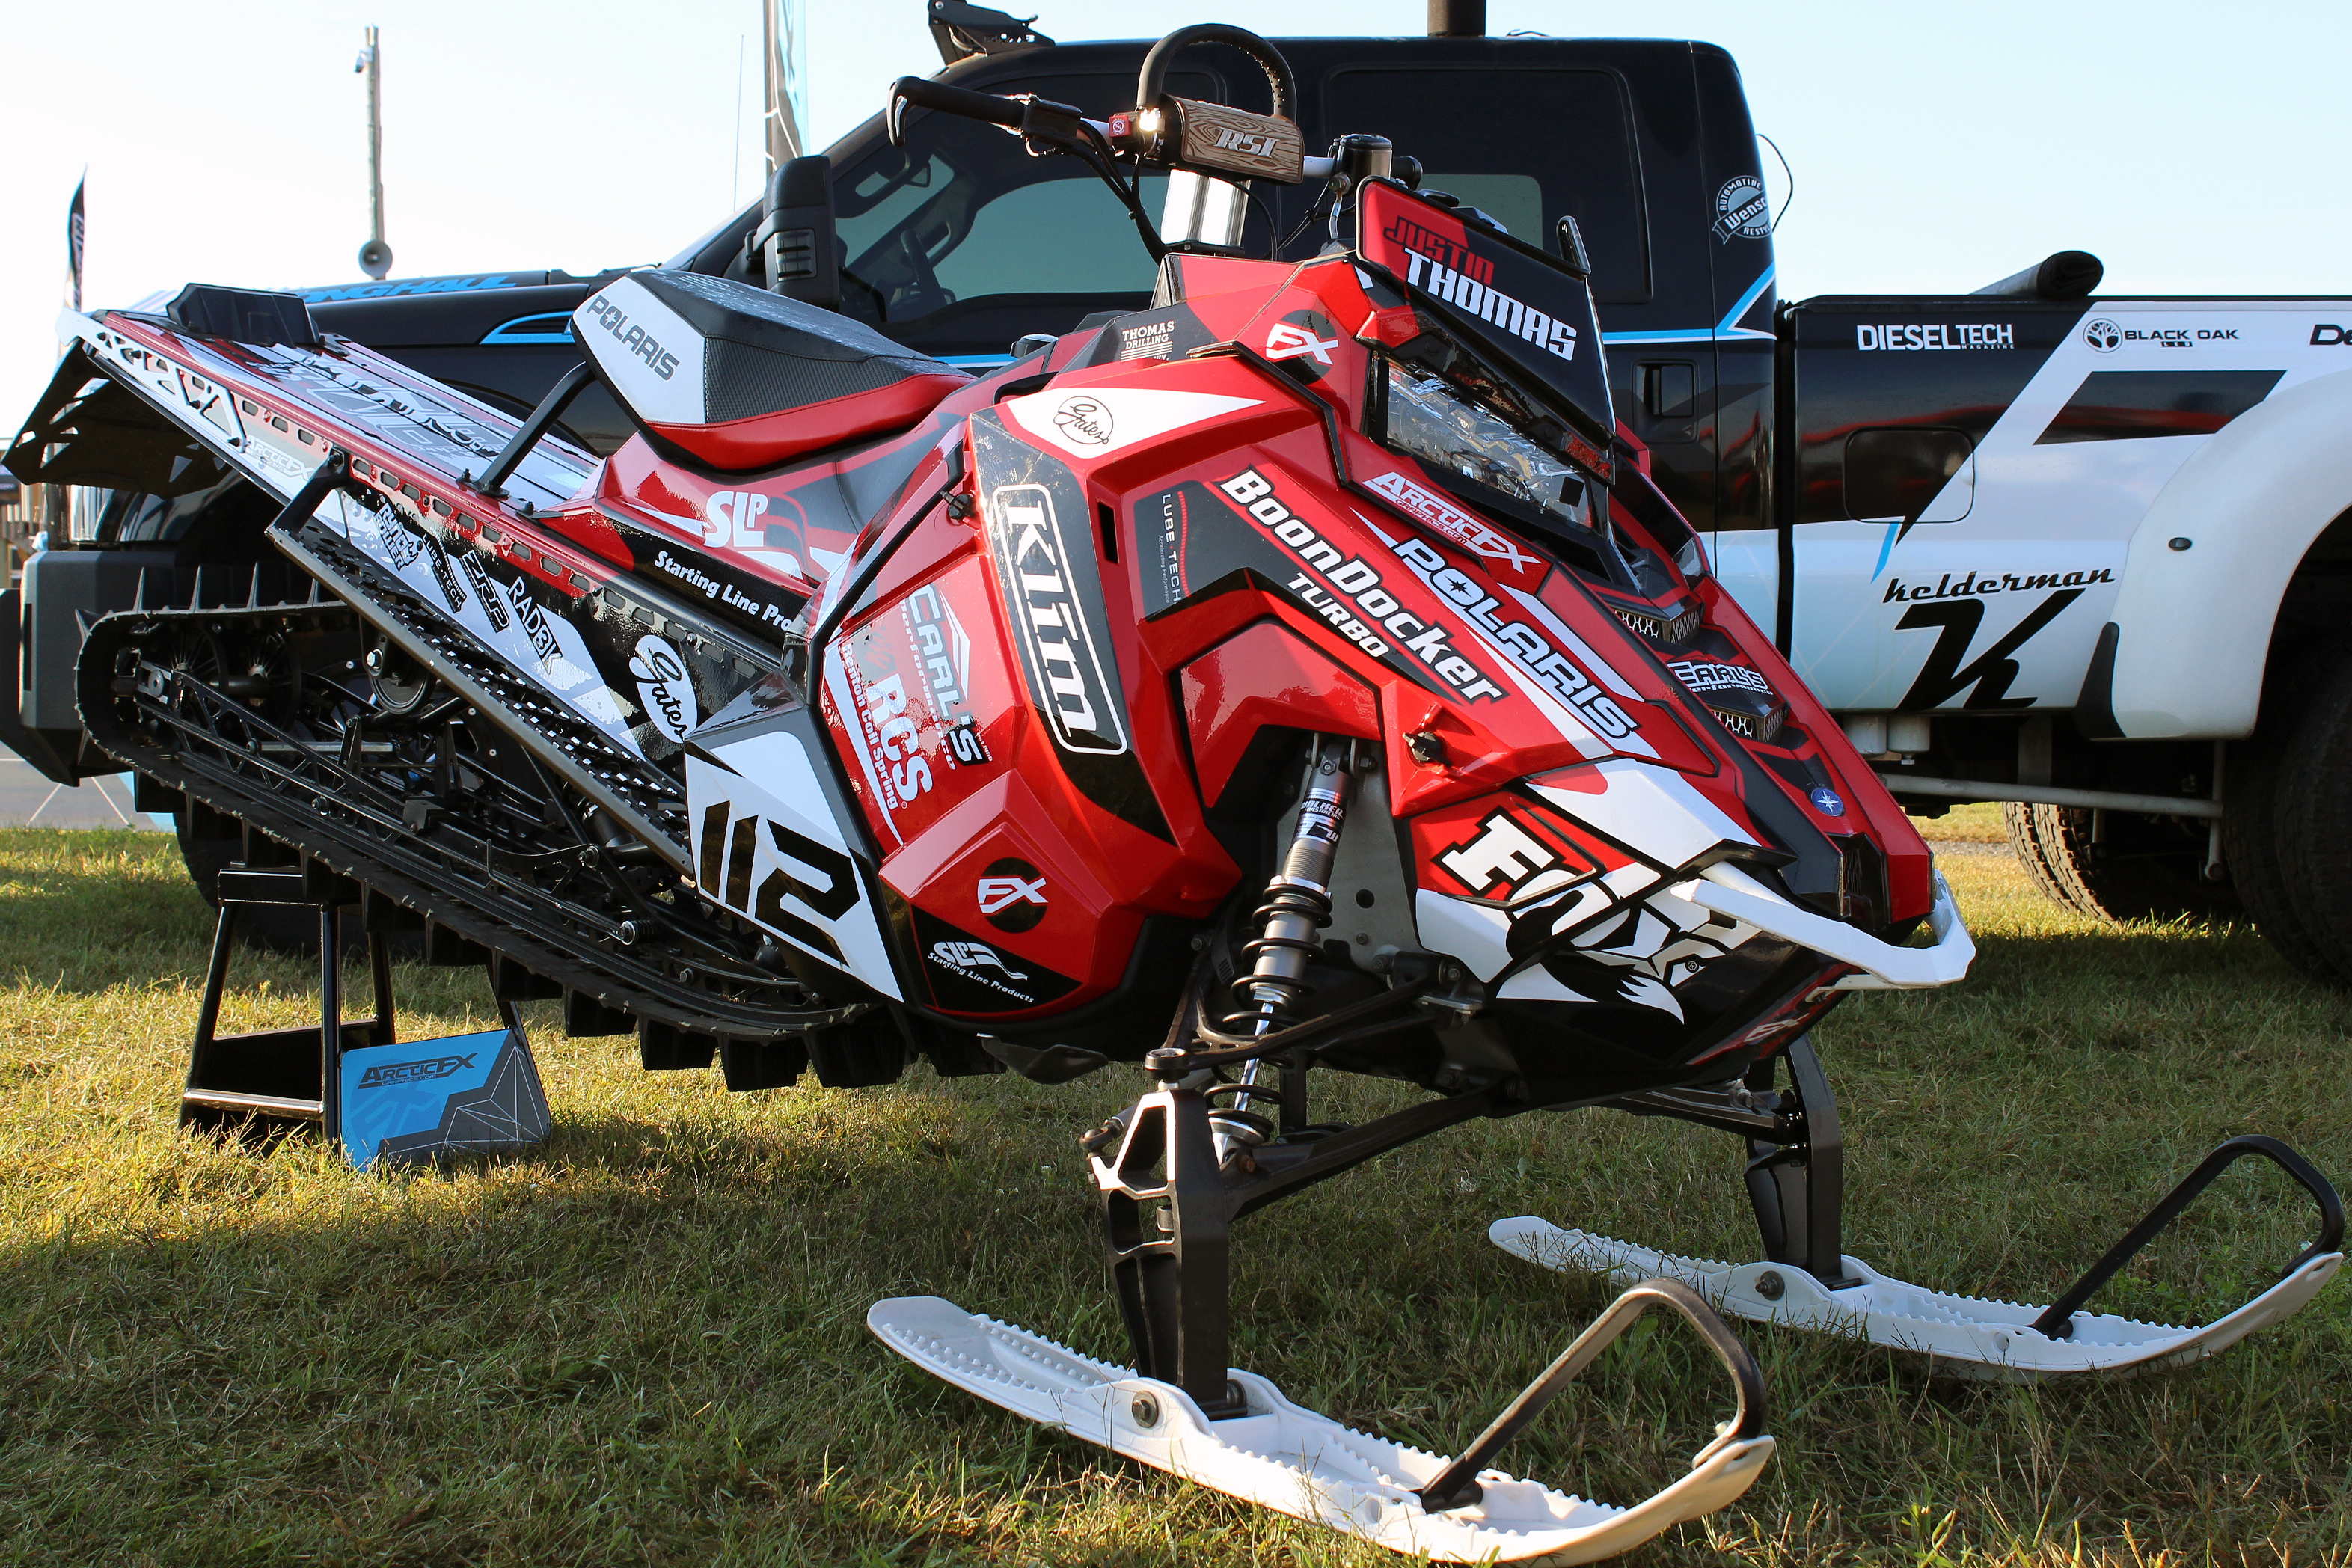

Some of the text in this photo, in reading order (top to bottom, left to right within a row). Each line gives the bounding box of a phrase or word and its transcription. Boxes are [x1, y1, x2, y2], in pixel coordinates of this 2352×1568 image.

[1213, 126, 1280, 158] RSI
[586, 294, 681, 382] POLARIS
[1122, 320, 1175, 342] THOMAS
[1404, 247, 1578, 361] THOMAS
[2125, 329, 2240, 340] BLACK OAK
[1125, 333, 1169, 351] DRILLING
[705, 490, 769, 548] SLP
[1162, 494, 1182, 602] LUBE TECH
[422, 533, 462, 609] LUBE TECH
[461, 549, 510, 628] ZRP
[654, 550, 720, 599] Starting
[720, 584, 760, 616] Line
[1882, 568, 2116, 604] kelderman
[1287, 572, 1390, 658] TURBO
[1392, 537, 1638, 739] POLARIS
[628, 647, 689, 744] Gates
[842, 643, 899, 811] Renton Coil Spring
[866, 673, 934, 802] RCS
[1302, 800, 1344, 819] WALKER
[928, 952, 1035, 1003] Starting Line Products
[933, 941, 978, 967] SLP
